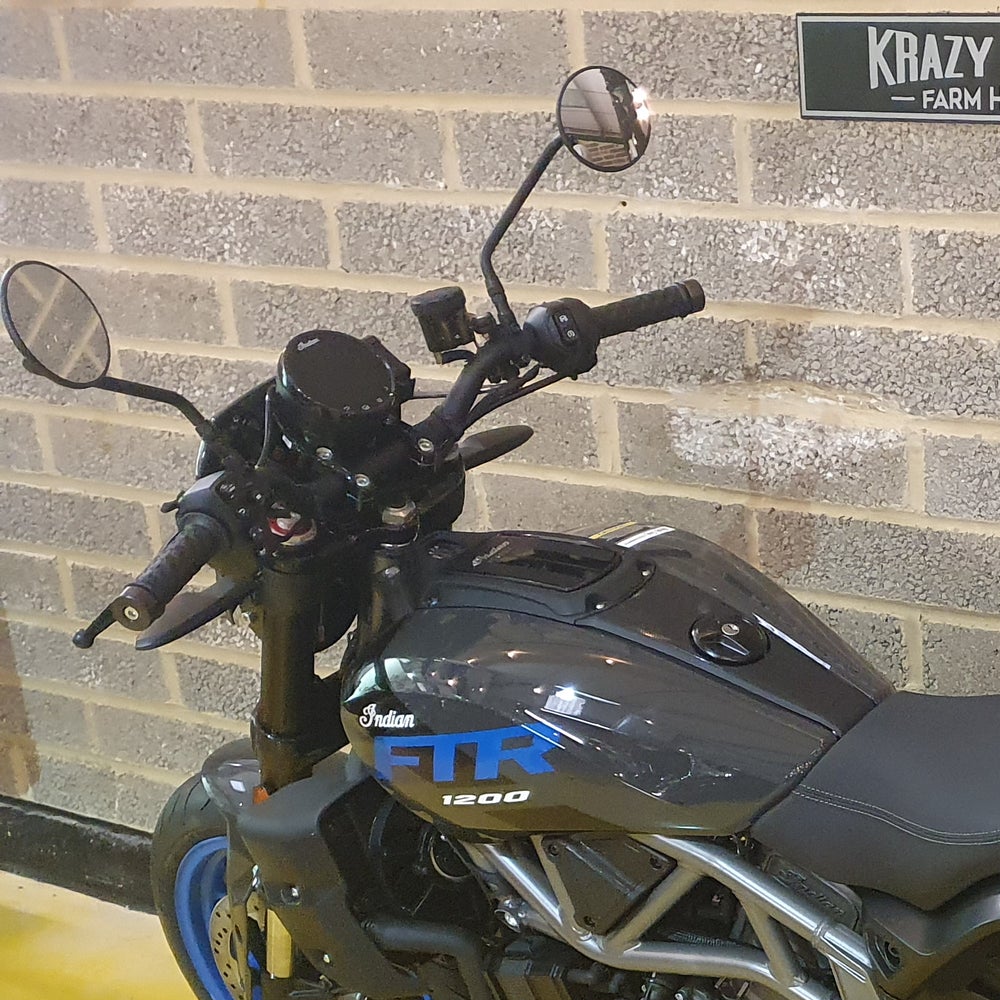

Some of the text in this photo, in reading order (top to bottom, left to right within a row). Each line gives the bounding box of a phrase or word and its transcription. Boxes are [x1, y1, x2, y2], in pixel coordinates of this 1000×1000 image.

[867, 26, 994, 90] KRAZY
[922, 87, 982, 111] FARM
[359, 703, 416, 729] Indian
[374, 721, 562, 784] FTR
[441, 790, 531, 806] 1200
